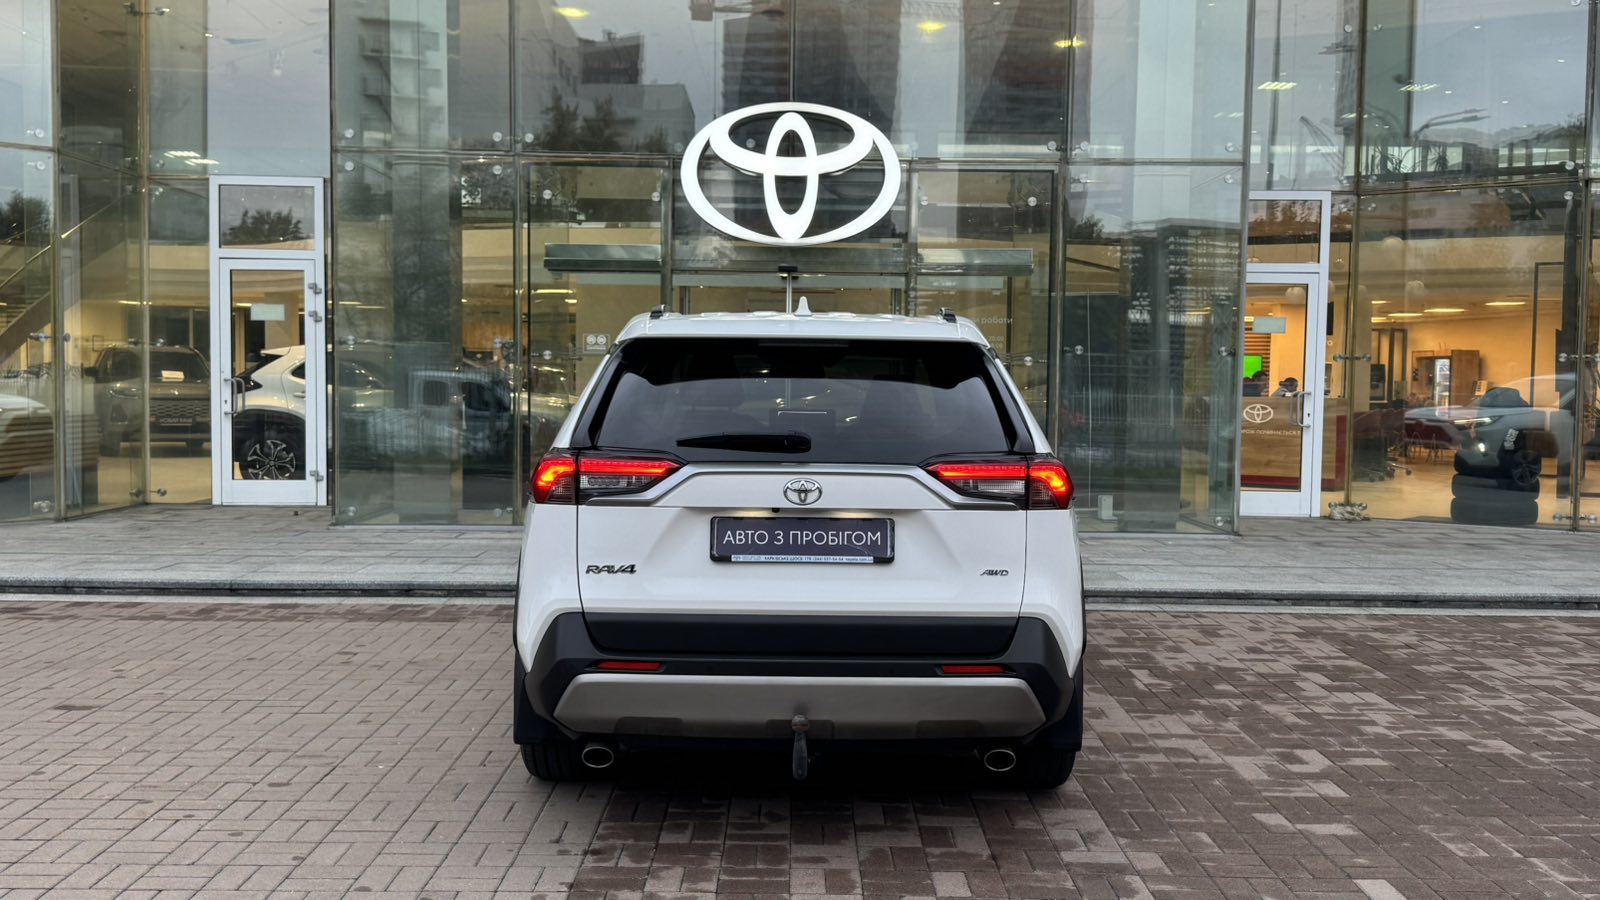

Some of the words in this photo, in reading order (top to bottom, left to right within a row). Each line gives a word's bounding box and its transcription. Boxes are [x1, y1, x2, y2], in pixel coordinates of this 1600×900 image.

[723, 530, 769, 545] АВТО
[790, 531, 881, 546] ПРОБІГОМ
[585, 564, 637, 575] RAV4
[979, 569, 1009, 577] AWD
